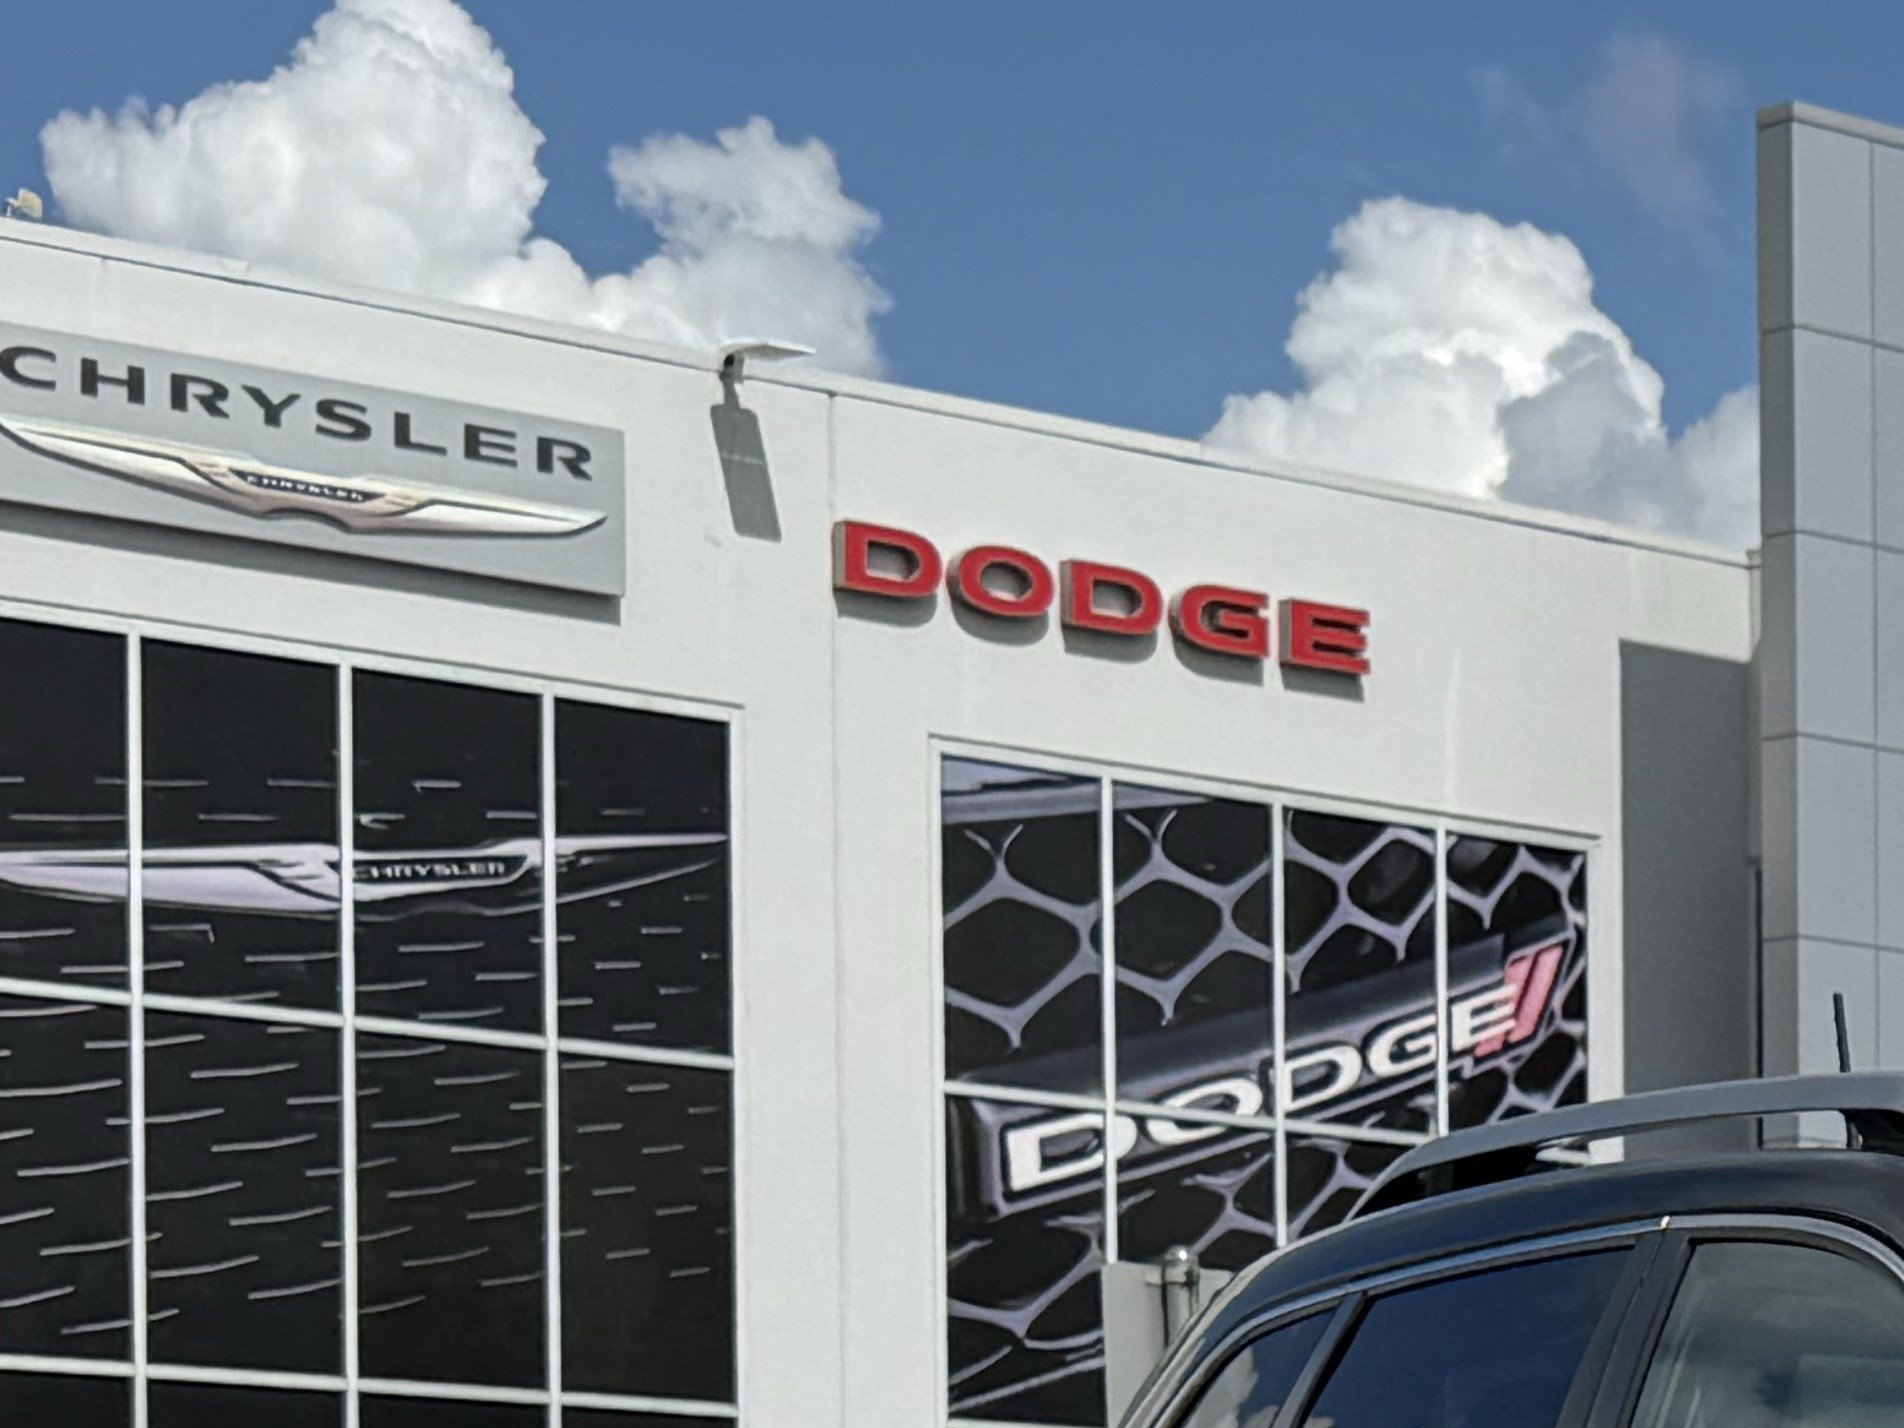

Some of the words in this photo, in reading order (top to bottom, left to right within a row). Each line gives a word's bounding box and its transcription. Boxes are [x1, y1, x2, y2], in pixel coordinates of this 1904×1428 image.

[0, 346, 593, 481] CHRYSLER
[832, 520, 1370, 675] DODGE
[1008, 984, 1518, 1191] DODGE
